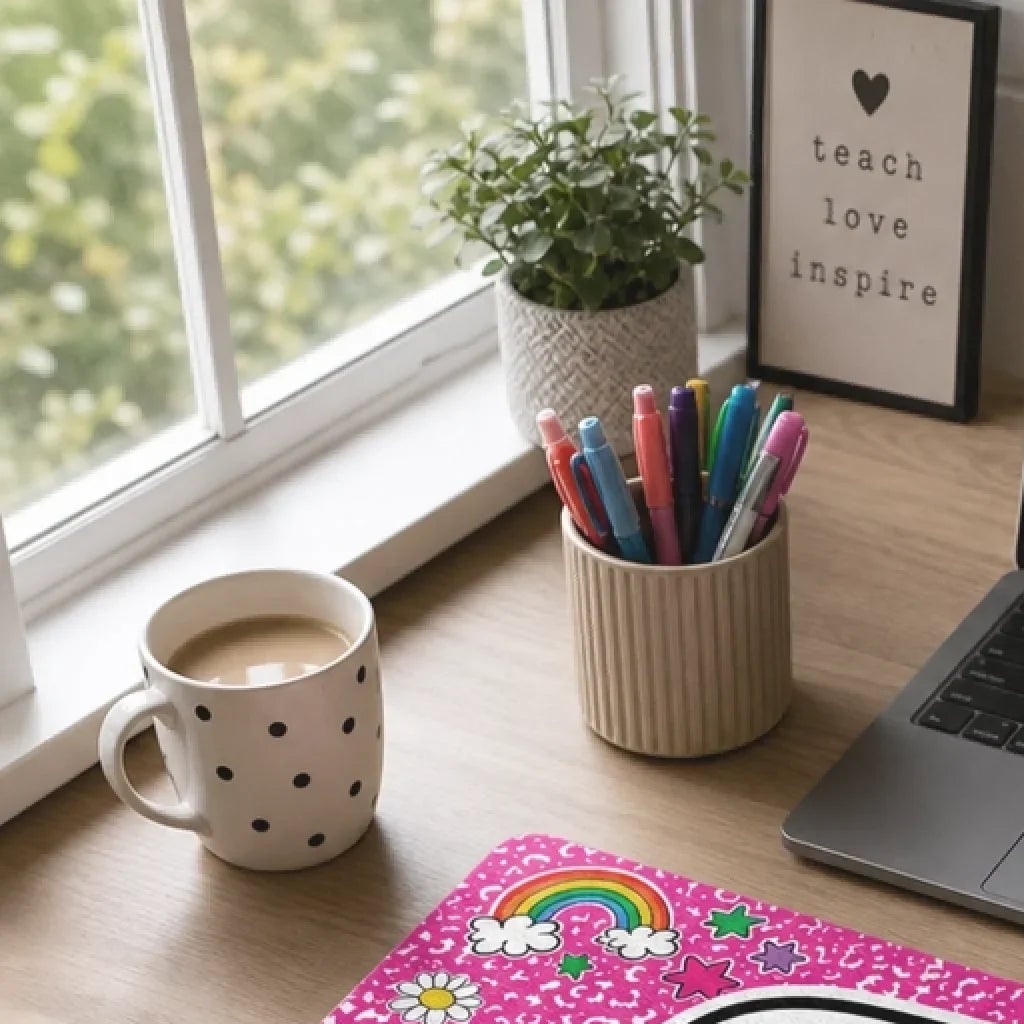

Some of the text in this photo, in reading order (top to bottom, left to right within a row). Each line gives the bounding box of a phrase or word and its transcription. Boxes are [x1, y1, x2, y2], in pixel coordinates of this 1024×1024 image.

[812, 135, 923, 181] teach
[823, 197, 909, 239] love
[790, 251, 937, 306] inspire
